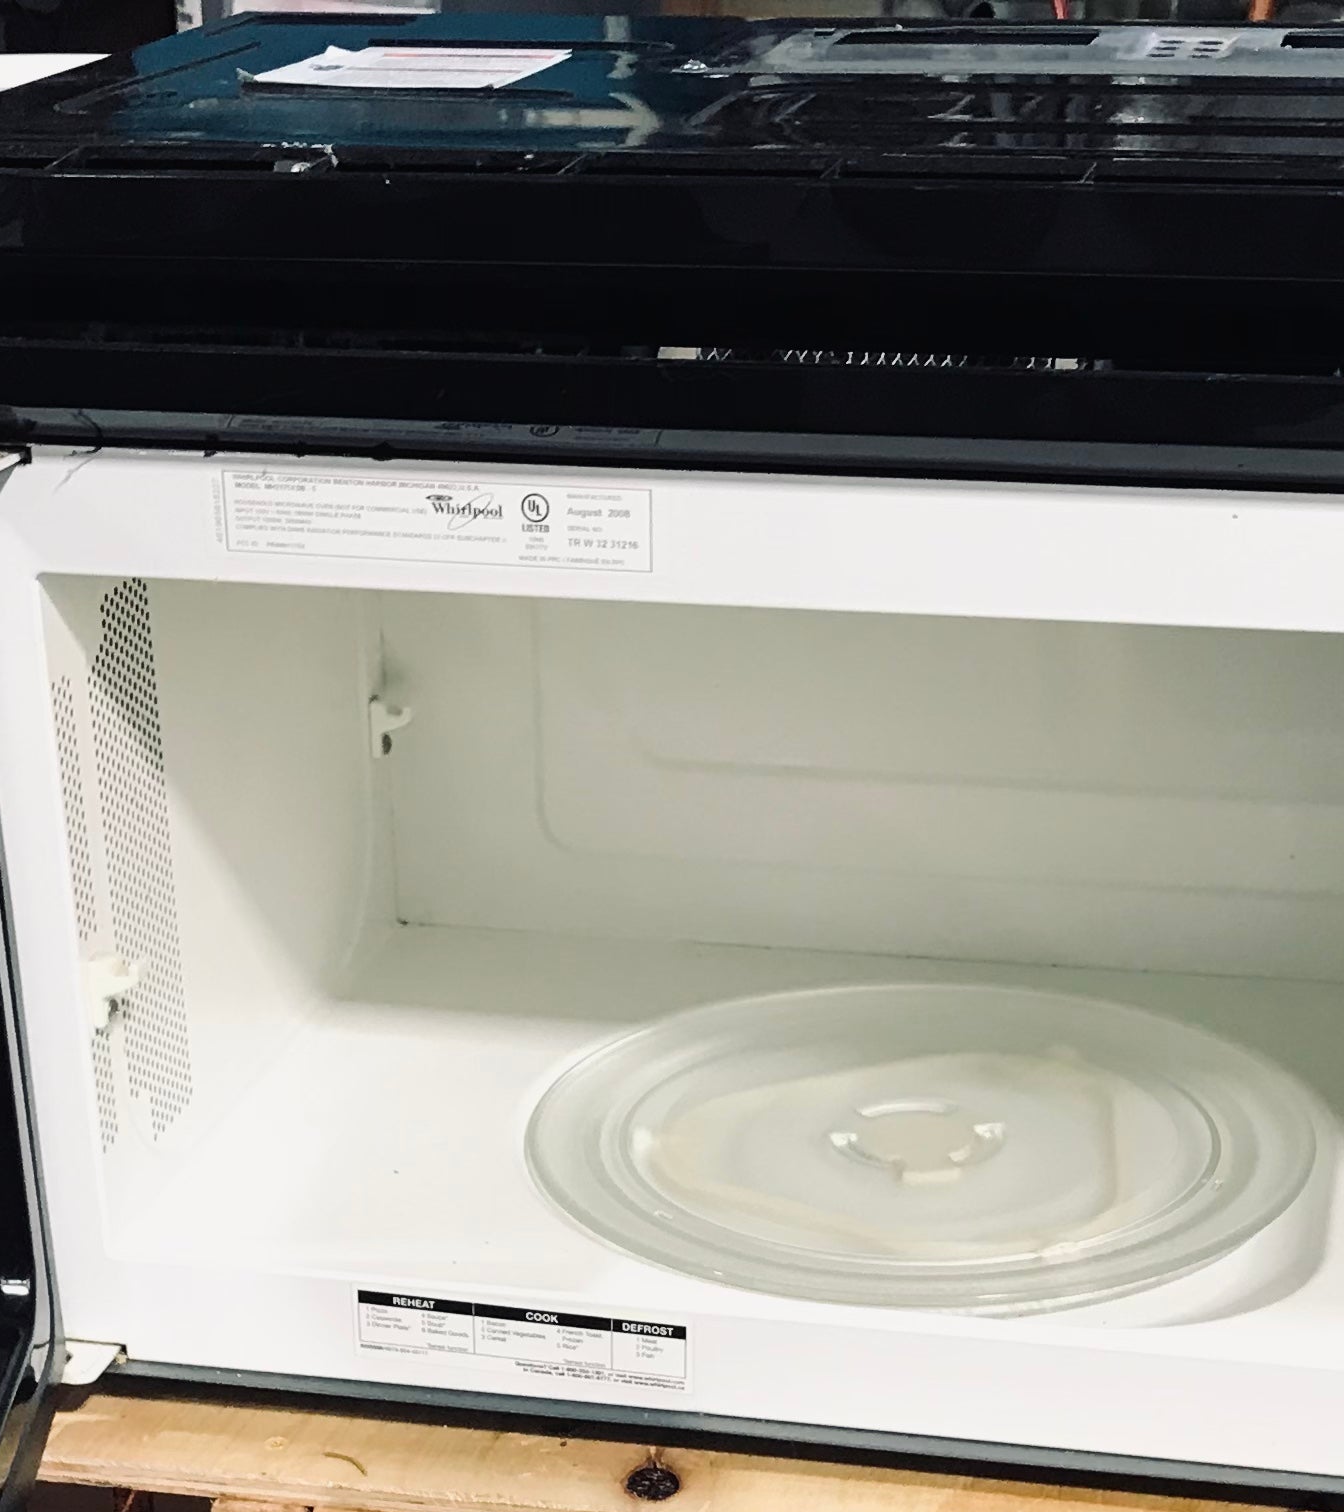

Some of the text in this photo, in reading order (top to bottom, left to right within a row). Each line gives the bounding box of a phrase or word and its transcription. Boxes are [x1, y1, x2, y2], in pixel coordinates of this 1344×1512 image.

[431, 501, 503, 519] Whirlpool
[567, 507, 602, 518] August
[521, 523, 550, 533] LISTED
[392, 1296, 435, 1309] REHEAT
[525, 1311, 559, 1323] COOK
[622, 1322, 674, 1336] DEFROST
